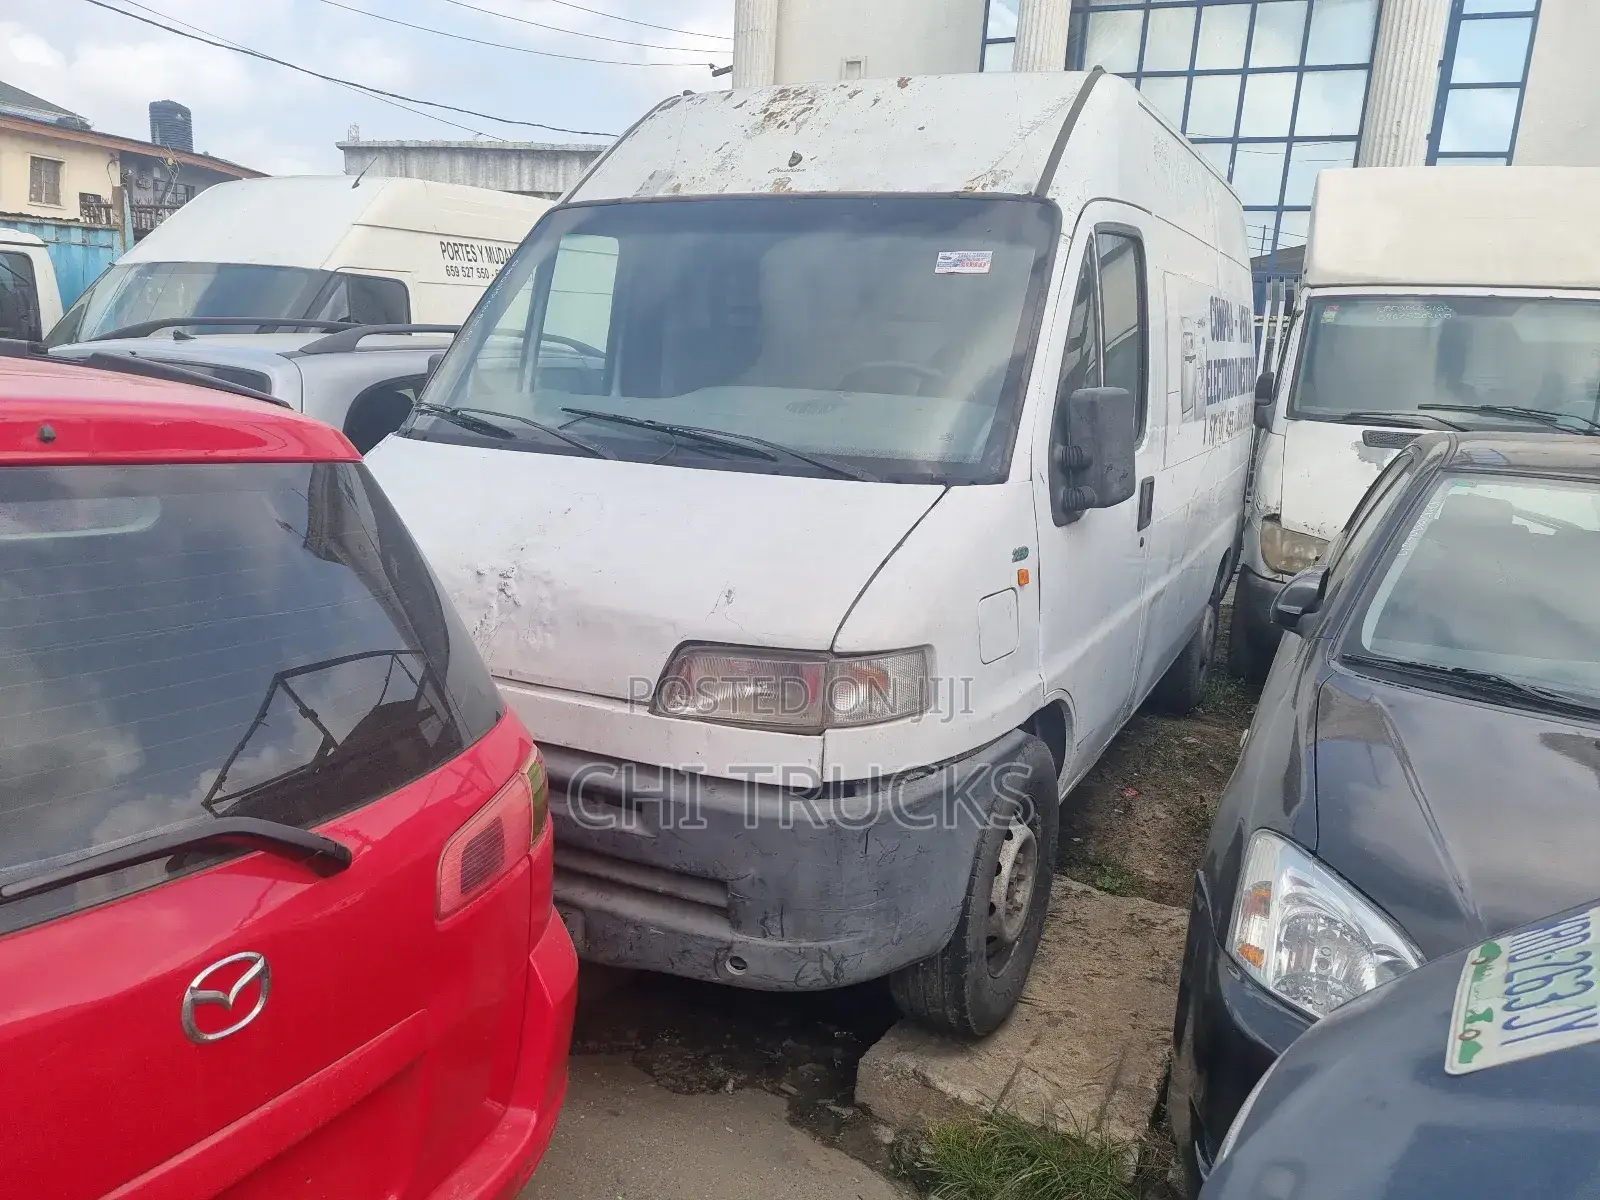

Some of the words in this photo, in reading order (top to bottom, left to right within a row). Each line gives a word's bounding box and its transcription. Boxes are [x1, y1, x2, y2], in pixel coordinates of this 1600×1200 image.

[440, 241, 477, 262] PORTES
[476, 245, 485, 263] Y
[446, 265, 459, 277] 659
[462, 267, 474, 278] 527
[477, 268, 489, 279] 550
